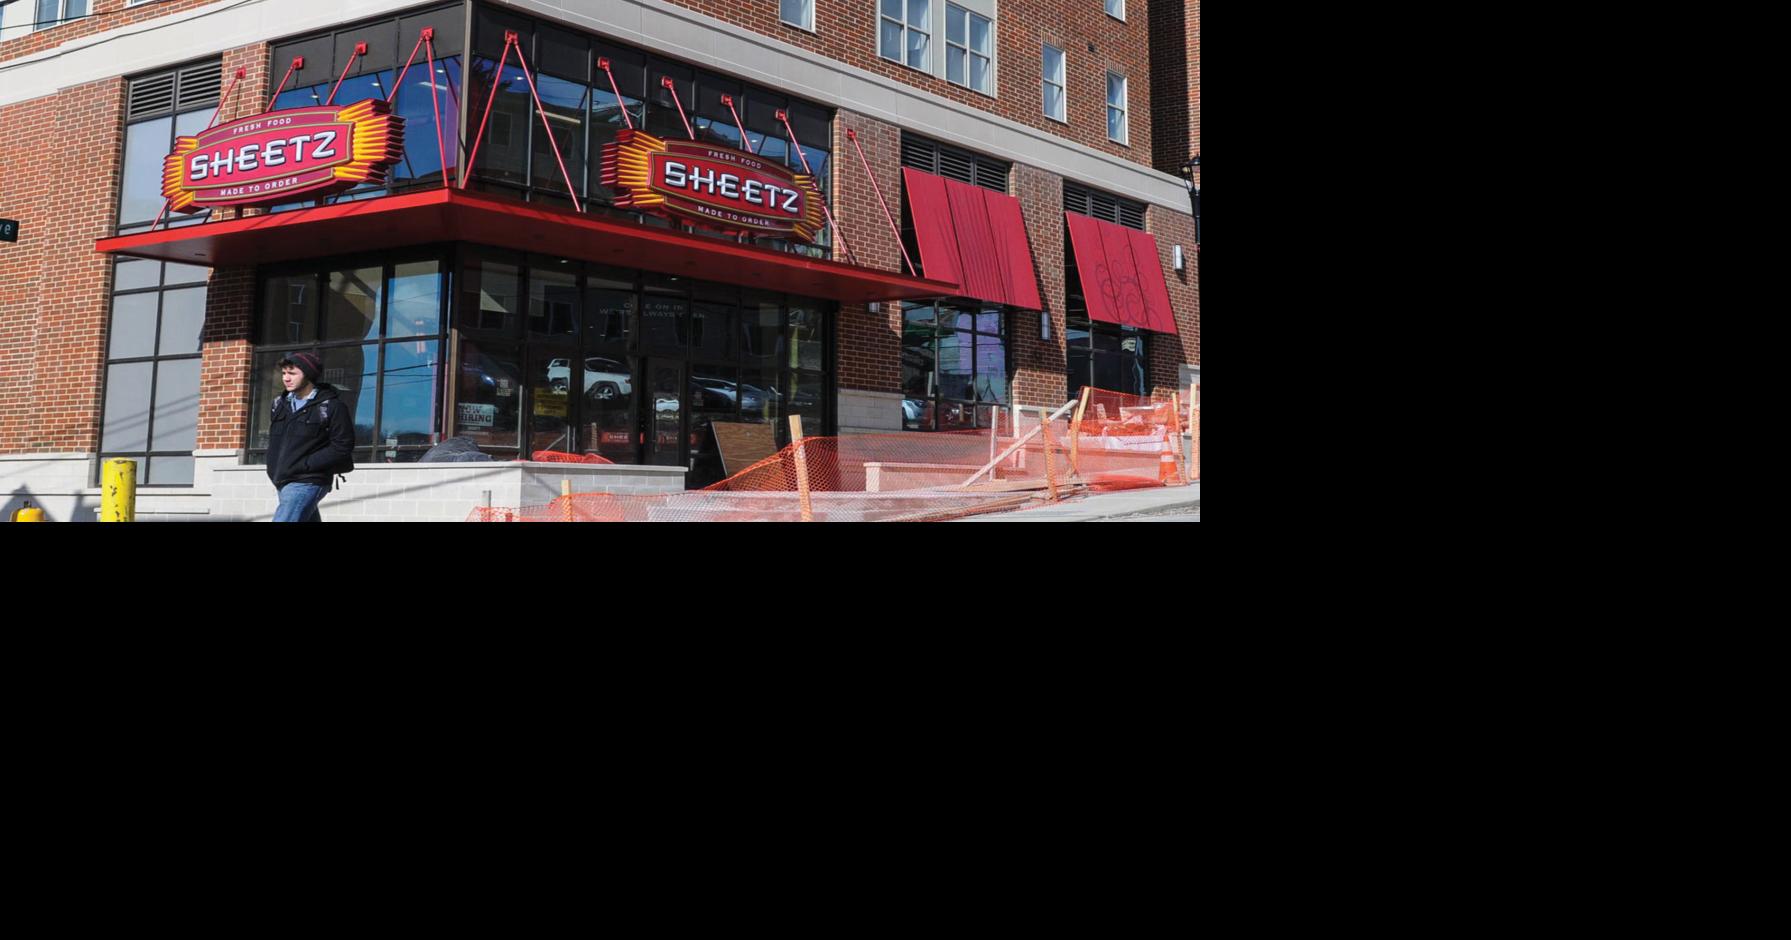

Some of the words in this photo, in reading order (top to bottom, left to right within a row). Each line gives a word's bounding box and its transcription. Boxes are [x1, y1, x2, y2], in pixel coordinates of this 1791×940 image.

[233, 122, 262, 135] FRESH
[267, 117, 292, 127] FOOD
[190, 130, 337, 181] SHEETZ
[708, 151, 736, 161] FRESH
[740, 157, 762, 169] FOOD
[220, 186, 244, 196] MADE
[249, 184, 261, 192] TO
[265, 177, 298, 190] ORDER
[664, 161, 799, 213] SHEETZ
[697, 205, 723, 217] MADE
[727, 213, 738, 221] TO
[741, 216, 770, 226] ORDER
